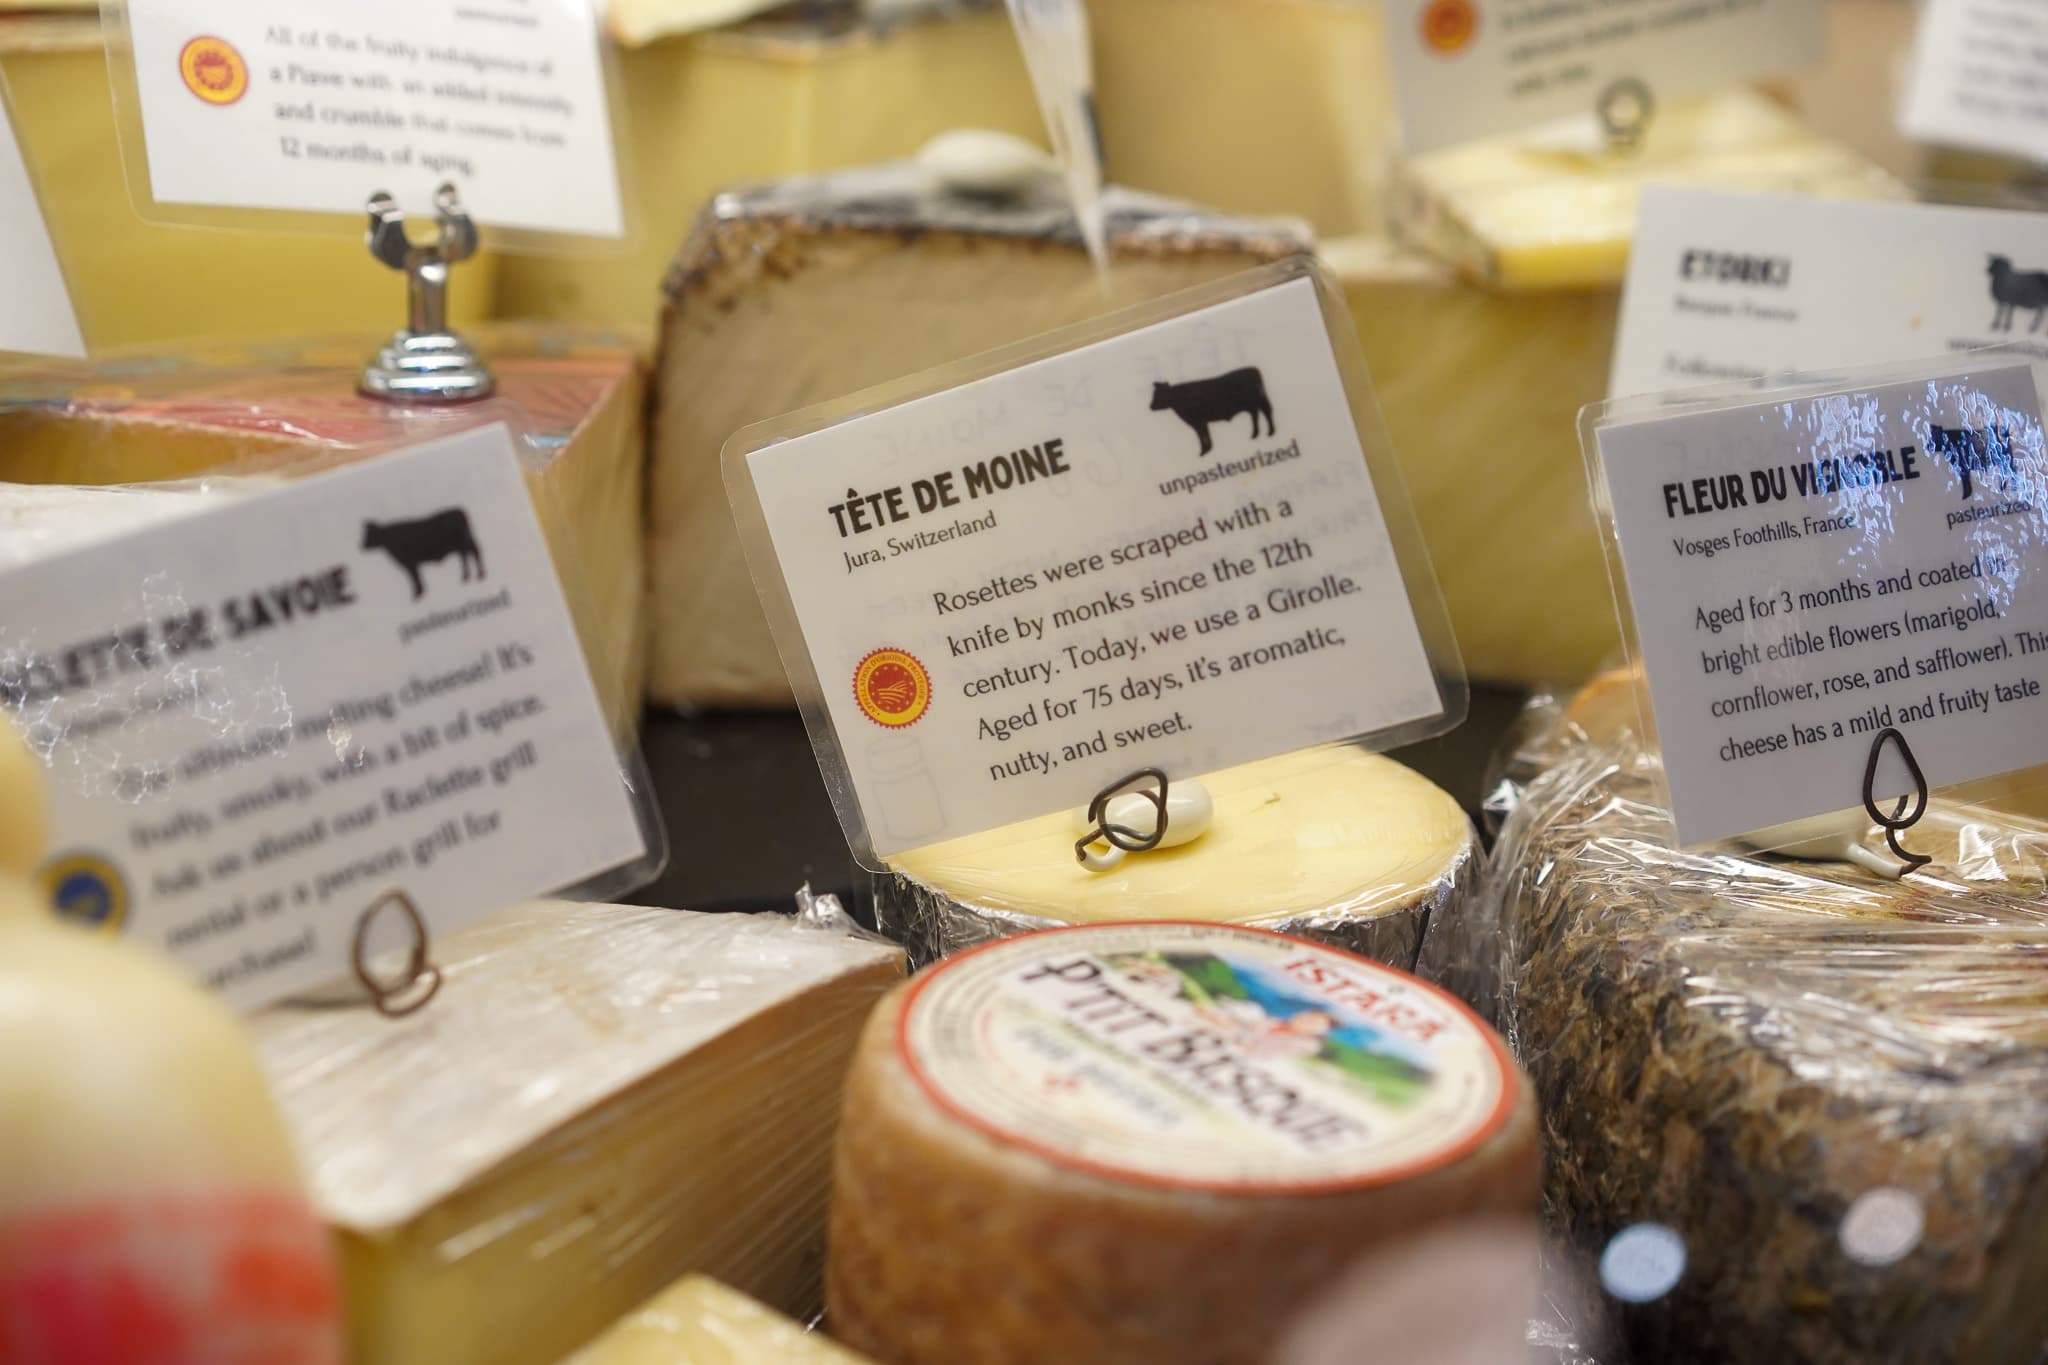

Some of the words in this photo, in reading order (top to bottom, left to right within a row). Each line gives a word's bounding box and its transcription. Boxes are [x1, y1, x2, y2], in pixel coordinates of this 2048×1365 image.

[828, 488, 909, 537] TÊTE
[912, 471, 960, 514] DE
[962, 438, 1070, 499] MOINE
[1159, 439, 1300, 495] unpasteurized
[1663, 473, 1747, 517] FLEUR
[1750, 467, 1787, 505] DU
[844, 549, 886, 574] Jura,
[887, 510, 997, 557] Switzerland
[933, 573, 1037, 615] Rosettes
[1043, 554, 1104, 583] were
[1111, 517, 1208, 565] scraped
[1214, 502, 1270, 535] with
[1279, 501, 1293, 518] a
[1673, 536, 1730, 558] Vosges
[1734, 520, 1802, 549] Foothills,
[1804, 514, 1855, 536] France
[222, 563, 356, 640] SAVOIE
[947, 625, 1009, 657] knife
[1014, 617, 1044, 640] by
[1053, 592, 1134, 628] monks
[1141, 571, 1207, 603] since
[1213, 557, 1256, 583] the
[1261, 538, 1313, 569] 12th
[1695, 599, 1745, 633] Aged
[1749, 594, 1776, 620] for
[1781, 592, 1793, 614] 3
[1799, 579, 1871, 611] months
[1876, 568, 1913, 594] and
[1919, 556, 1981, 586] coated
[963, 660, 1060, 697] century.
[1063, 637, 1146, 669] Today,
[1150, 624, 1188, 645] we
[1195, 609, 1239, 634] use
[1247, 604, 1261, 621] a
[1267, 575, 1361, 613] Girolle.
[1702, 645, 1762, 675] bright
[1767, 631, 1825, 661] edible
[1828, 620, 1901, 651] flowers
[1904, 598, 2001, 635] (marigold,
[978, 703, 1038, 741] Aged
[1043, 698, 1077, 722] for
[1082, 684, 1113, 709] 75
[1120, 671, 1183, 700] days,
[1186, 656, 1222, 684] it's
[1228, 627, 1345, 672] aromatic,
[1711, 681, 1820, 718] cornflower,
[1823, 671, 1870, 696] rose,
[1875, 657, 1910, 684] and
[1916, 635, 2013, 676] safflower).
[990, 751, 1058, 780] nutty,
[1063, 730, 1107, 763] and
[1113, 712, 1192, 748] sweet.
[1719, 729, 1788, 763] cheese
[1792, 721, 1827, 746] has
[1831, 721, 1844, 738] a
[1849, 704, 1893, 735] mild
[1899, 695, 1935, 724] and
[1938, 688, 1990, 716] fruity
[1994, 677, 2041, 703] taste
